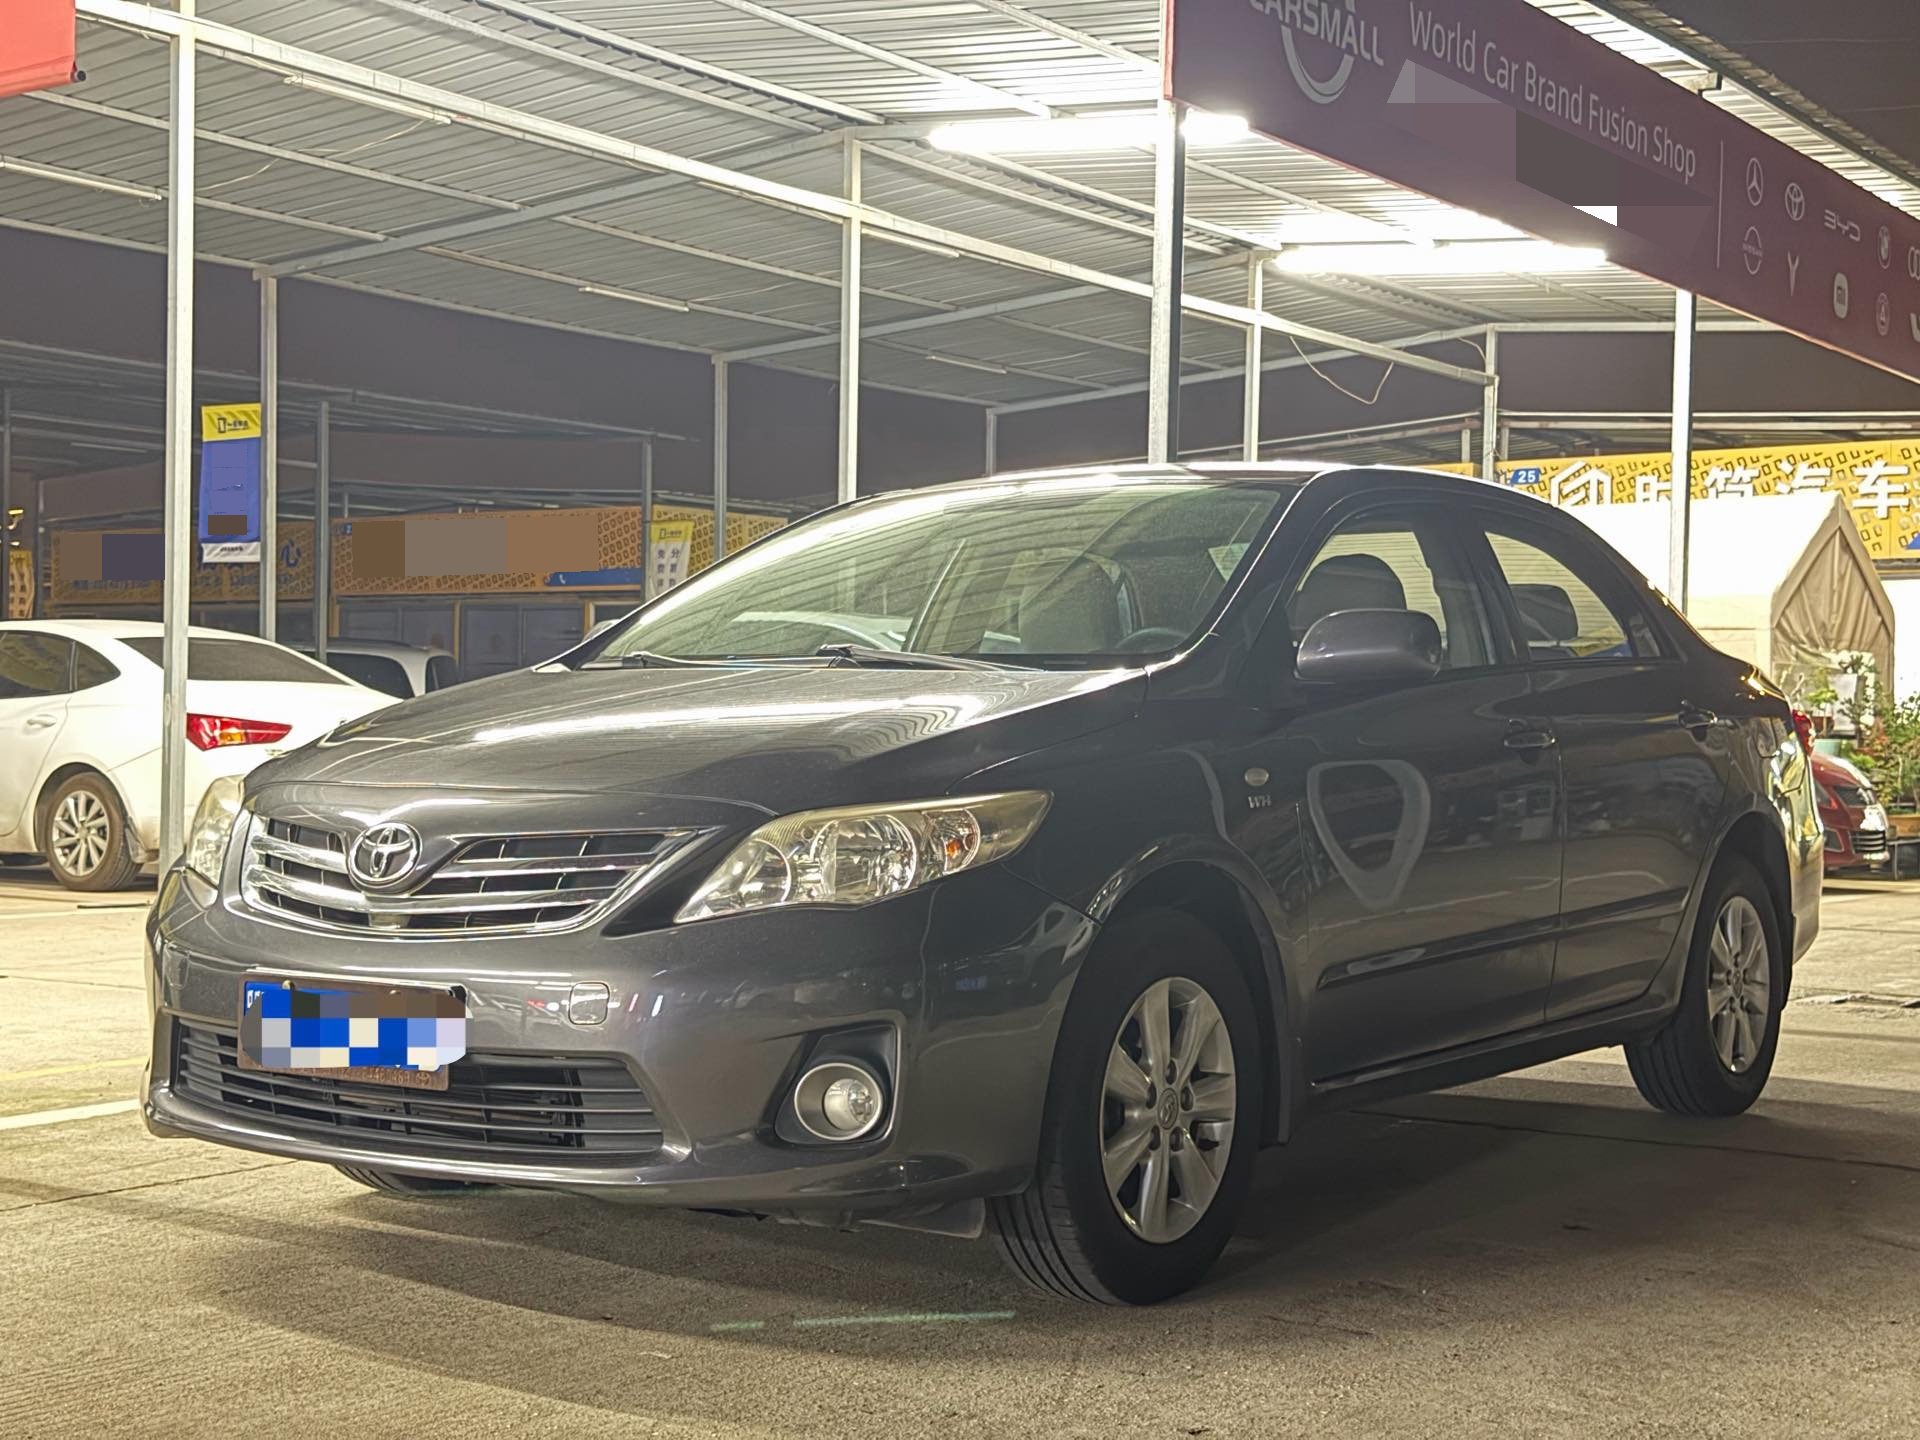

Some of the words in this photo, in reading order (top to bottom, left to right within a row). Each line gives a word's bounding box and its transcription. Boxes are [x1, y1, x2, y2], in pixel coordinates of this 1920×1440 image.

[1410, 1, 1476, 74] World
[1484, 41, 1519, 93] Car
[1525, 60, 1582, 125] Brand
[1588, 92, 1648, 157] Fusion
[1652, 125, 1696, 185] Shop
[1518, 470, 1536, 483] 25
